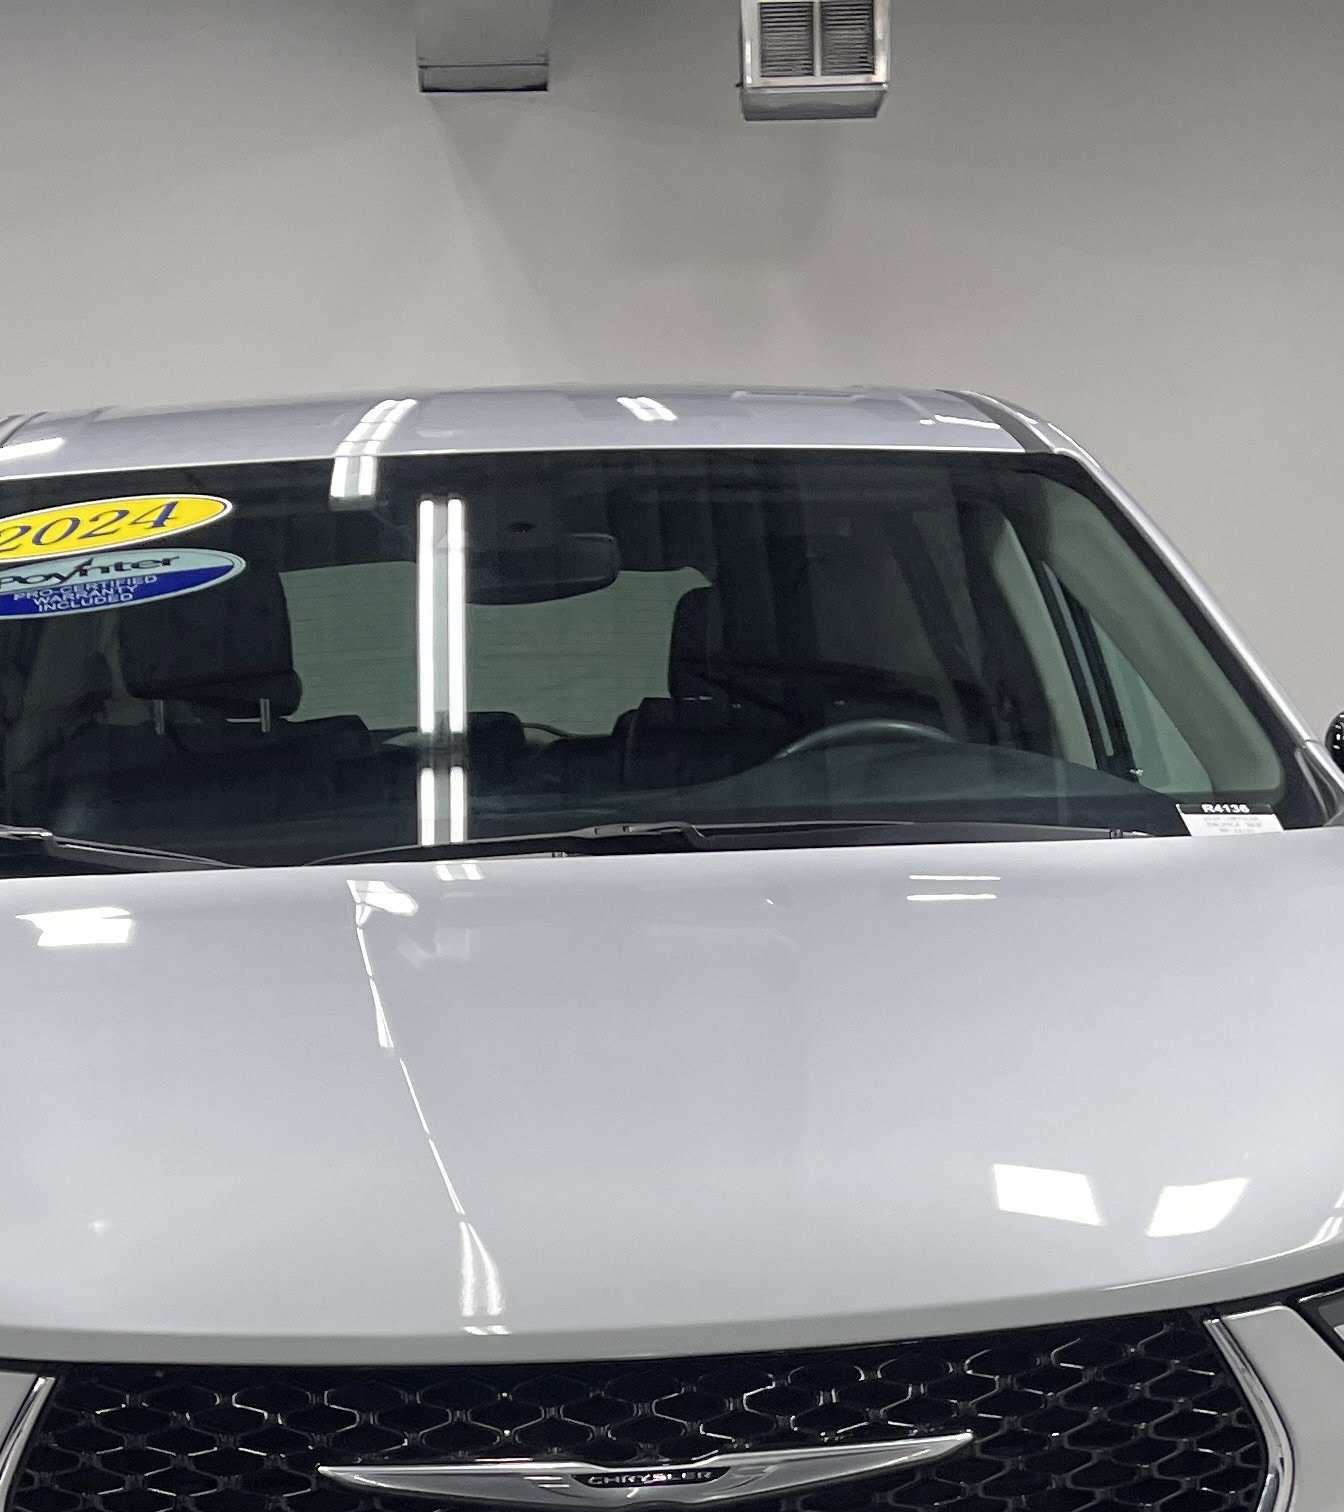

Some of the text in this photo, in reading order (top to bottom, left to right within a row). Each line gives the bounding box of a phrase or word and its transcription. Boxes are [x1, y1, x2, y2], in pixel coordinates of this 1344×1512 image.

[13, 575, 158, 600] PRO-CERTIFIED
[33, 584, 139, 605] WARRANTY
[38, 592, 134, 612] INCLUDED
[588, 1471, 712, 1484] CHRYSLER
